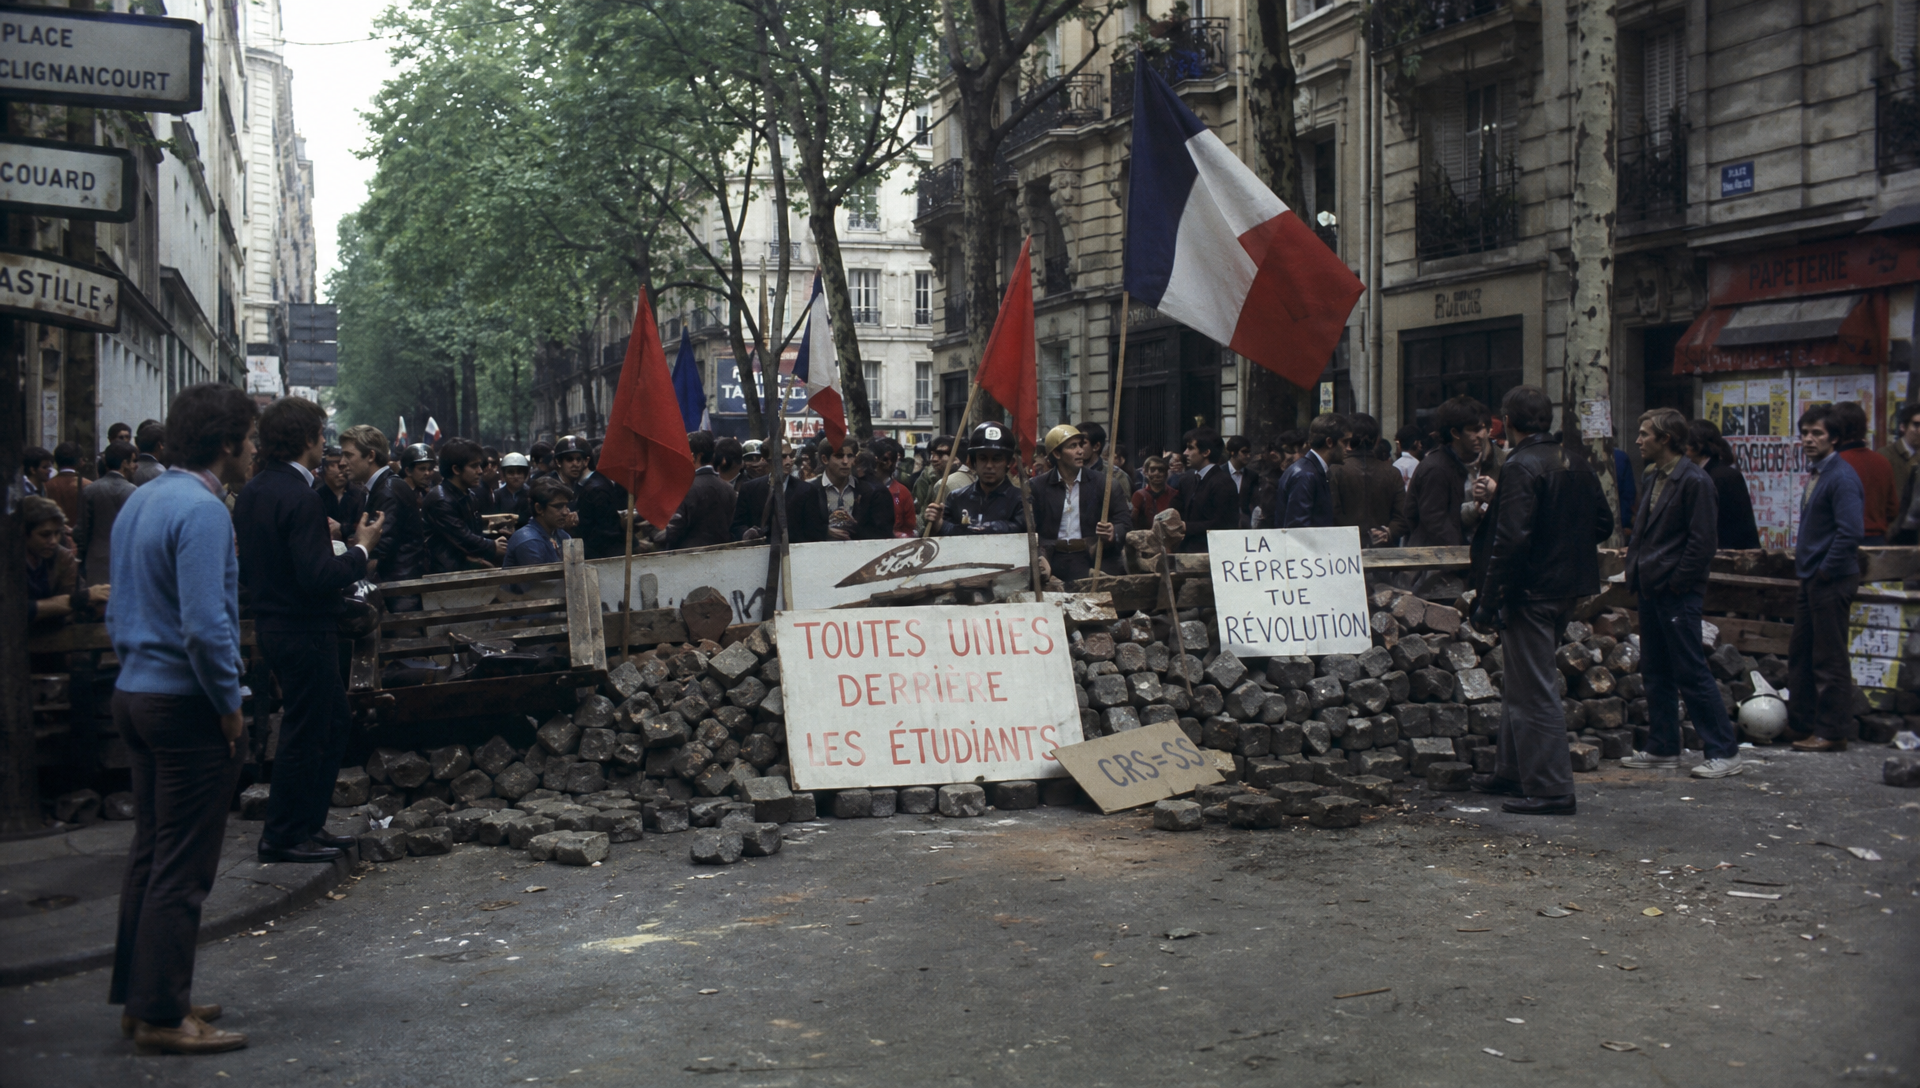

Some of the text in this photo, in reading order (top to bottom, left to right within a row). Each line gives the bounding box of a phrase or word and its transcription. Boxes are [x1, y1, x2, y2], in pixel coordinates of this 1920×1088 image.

[3, 23, 73, 48] PLACE
[0, 59, 170, 91] CLIGNANCOURT
[1, 162, 96, 191] COUARD
[1750, 251, 1849, 290] PAPETERIE
[1244, 536, 1271, 553] LA
[1221, 553, 1361, 582] RÉPRESSION
[1264, 588, 1311, 606] TUE
[793, 610, 1054, 660] TOUTES UNIES
[837, 664, 1008, 708] DERRIÈRE
[806, 720, 1061, 767] LES ÉTUDIANTS
